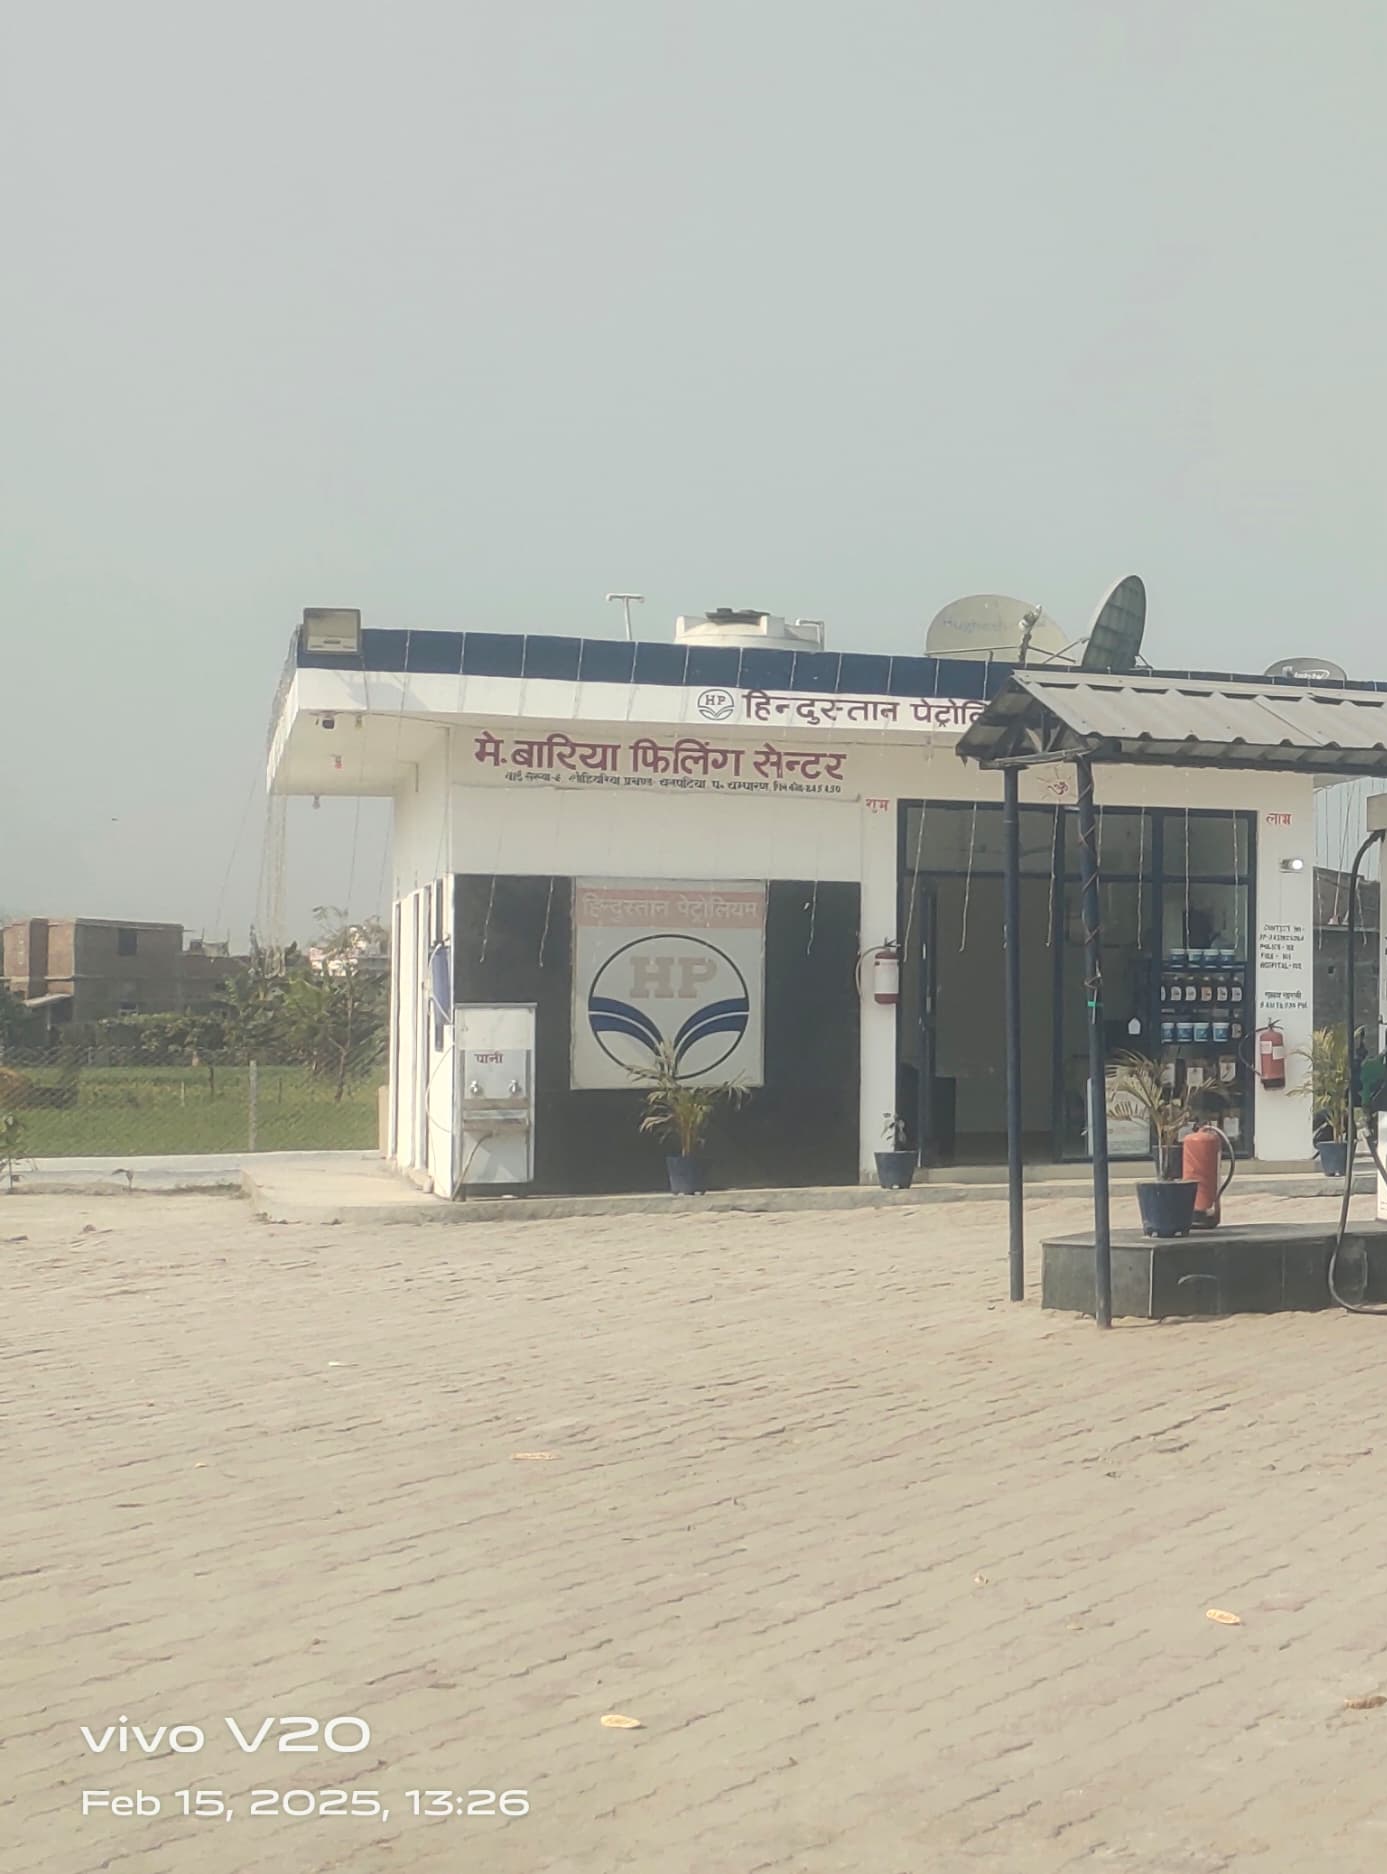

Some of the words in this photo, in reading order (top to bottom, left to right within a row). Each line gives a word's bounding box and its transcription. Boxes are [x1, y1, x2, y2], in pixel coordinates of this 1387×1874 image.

[705, 694, 726, 707] HP
[742, 688, 900, 725] हिन्दुस्तान
[511, 733, 622, 772] बारिया
[629, 738, 746, 776] फिलिंग
[753, 742, 848, 780] सेन्टर
[583, 892, 670, 921] हिन्दुस्तान
[676, 893, 758, 923] पेट्रोलियम
[630, 955, 719, 998] HP
[473, 1050, 504, 1065] पानी
